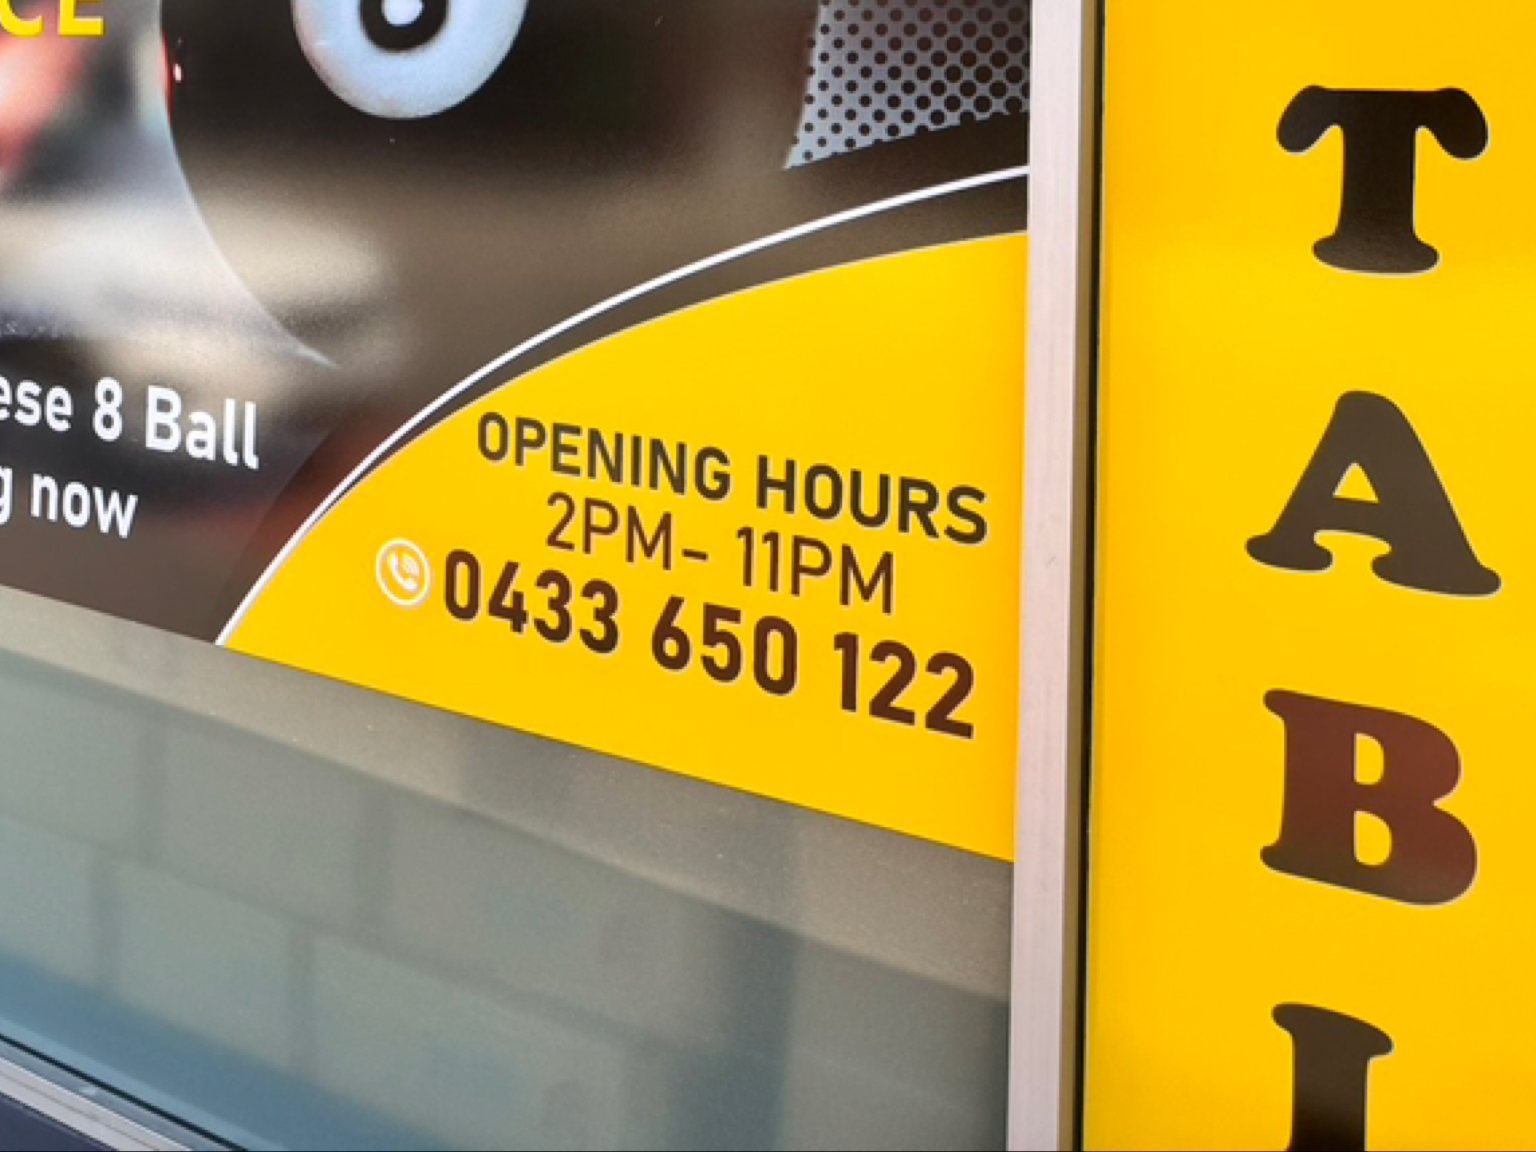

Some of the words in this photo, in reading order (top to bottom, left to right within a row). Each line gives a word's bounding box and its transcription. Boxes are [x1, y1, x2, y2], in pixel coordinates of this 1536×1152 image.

[92, 377, 123, 441] 8
[145, 384, 259, 469] Ball
[31, 473, 138, 539] now
[478, 412, 731, 502] OPENING
[756, 454, 988, 544] HOURS
[736, 525, 894, 614] 11PM
[444, 549, 619, 654] 0433
[652, 595, 797, 696] 650
[833, 631, 975, 739] 122
